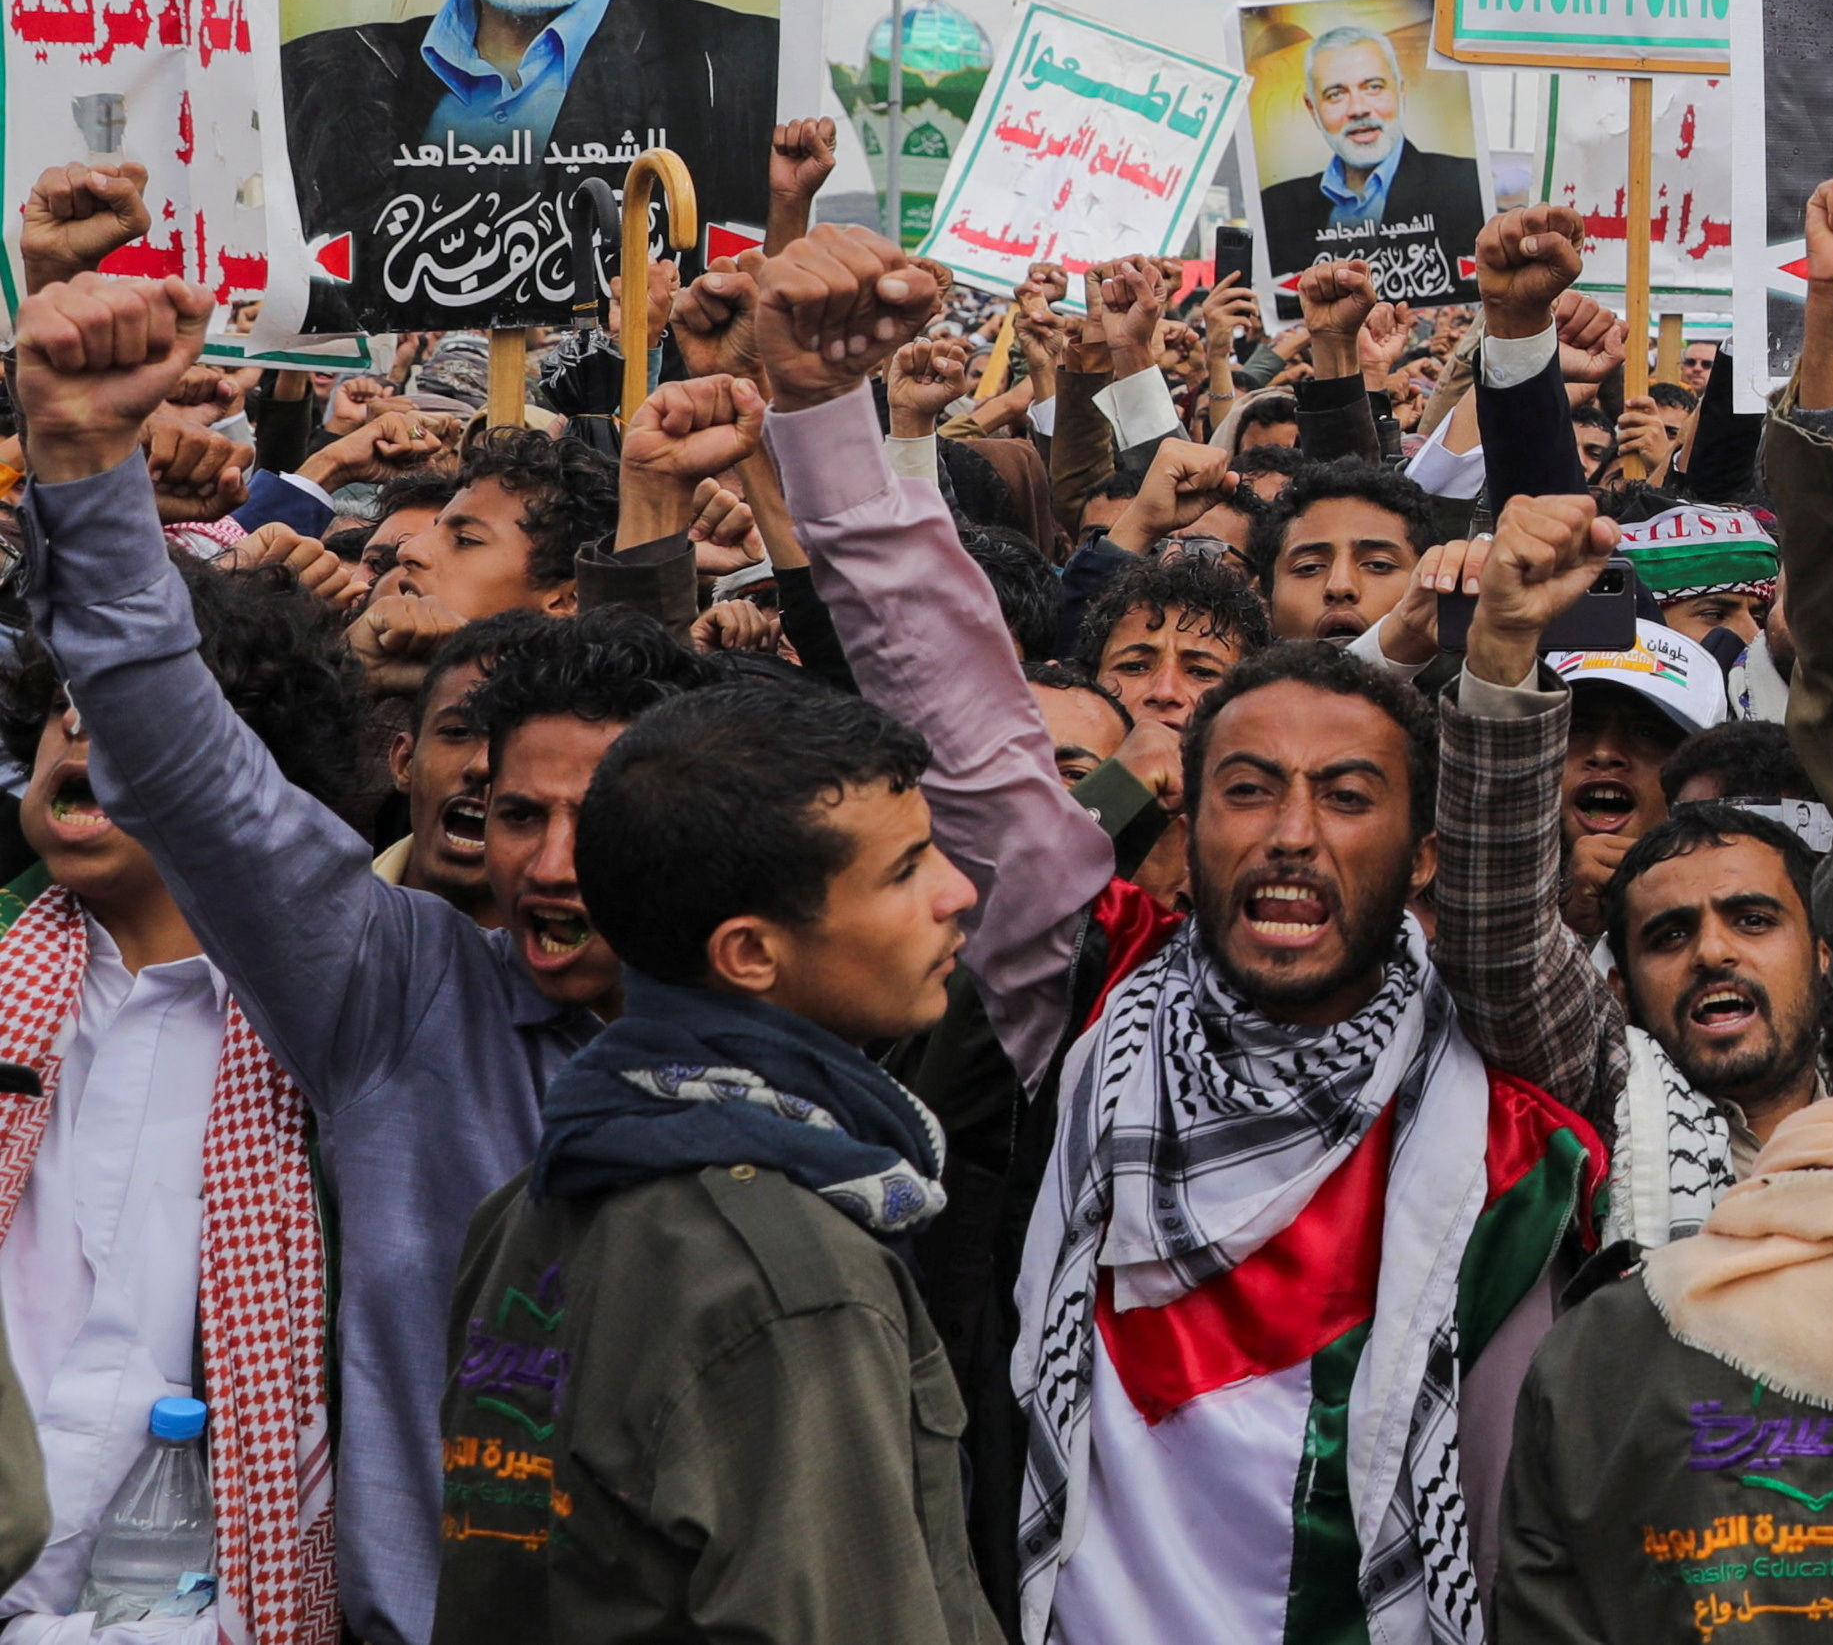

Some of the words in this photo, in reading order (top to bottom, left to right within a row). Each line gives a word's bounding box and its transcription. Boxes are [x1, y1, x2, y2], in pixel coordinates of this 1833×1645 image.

[1018, 30, 1214, 140] قاطعوا
[176, 89, 196, 167] و
[544, 128, 667, 173] الشهيد
[1676, 104, 1696, 160] و
[393, 129, 531, 174] المجاهد
[1089, 137, 1183, 201] البضائع
[1052, 178, 1073, 211] و
[1315, 218, 1375, 243] المجاهد
[1379, 213, 1435, 239] الشهيد
[1646, 637, 1689, 664] طوفان
